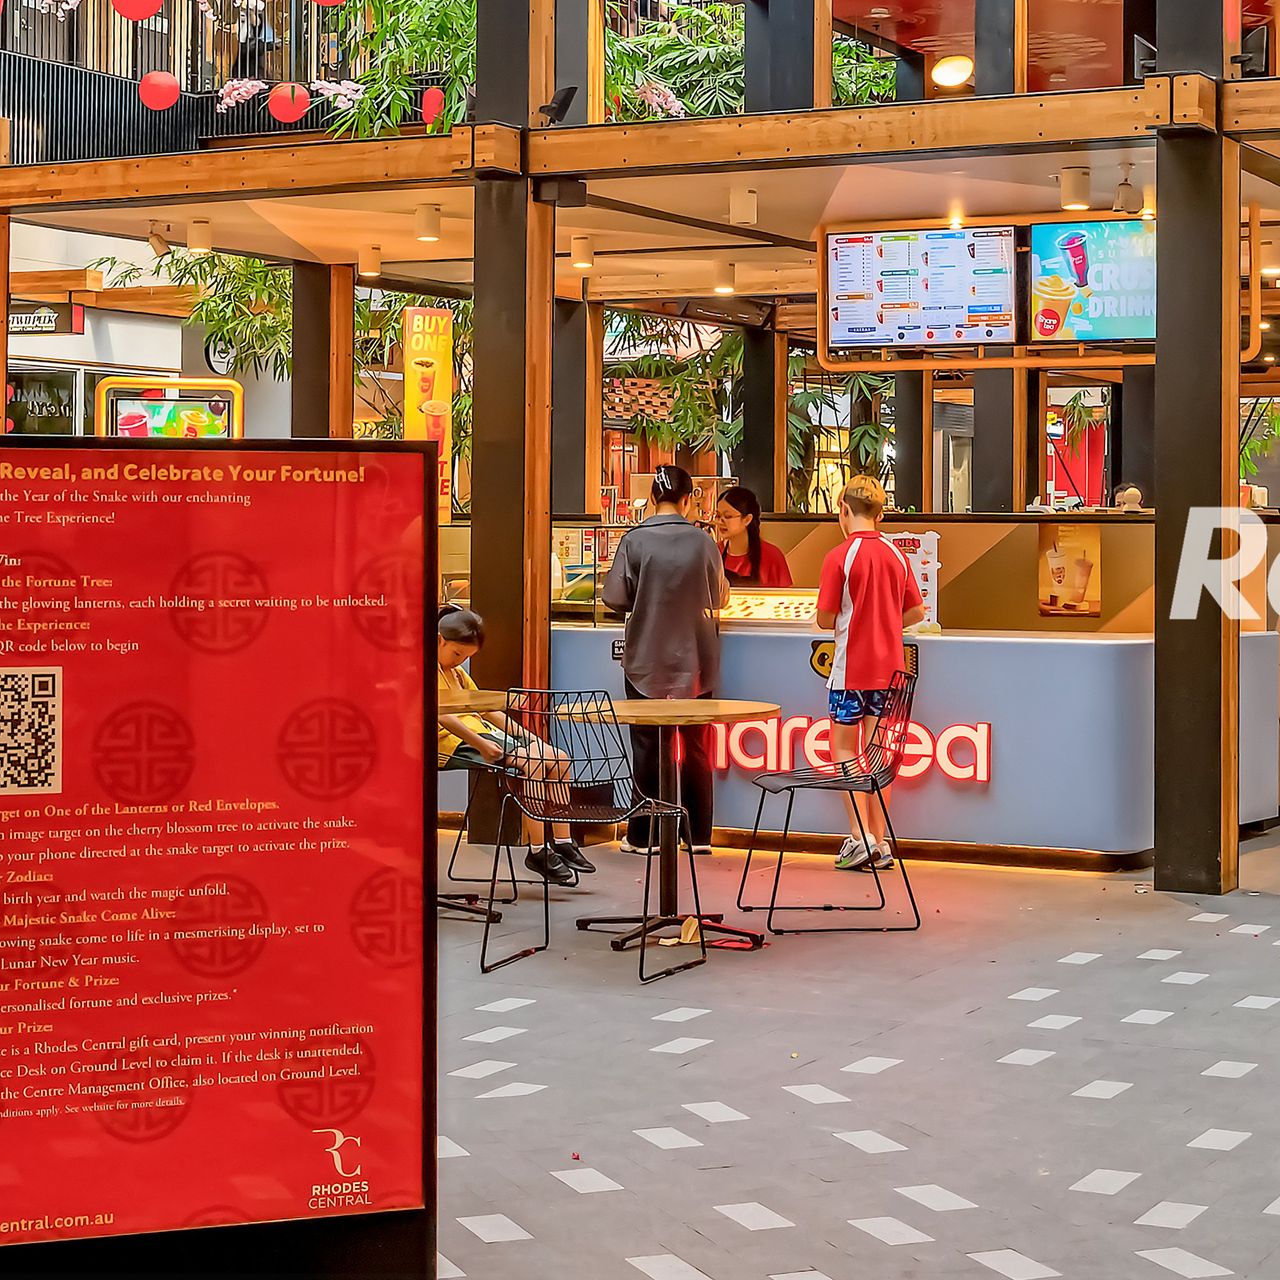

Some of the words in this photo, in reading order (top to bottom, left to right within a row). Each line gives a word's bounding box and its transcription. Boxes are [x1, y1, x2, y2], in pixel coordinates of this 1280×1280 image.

[412, 314, 449, 334] BUY
[411, 333, 448, 352] ONE
[0, 462, 76, 482] Reveal,
[81, 463, 119, 480] and
[123, 463, 223, 481] Celebrate
[228, 465, 276, 481] Your
[280, 465, 365, 482] Fortune!
[13, 510, 42, 523] Tree
[46, 511, 115, 526] Experience!
[1, 575, 21, 587] the
[26, 575, 76, 587] Fortune
[80, 575, 112, 587] Tree:
[17, 618, 90, 633] Experience:
[18, 639, 47, 652] code
[51, 638, 87, 651] below
[90, 642, 103, 651] to
[106, 638, 139, 654] begin
[24, 809, 40, 817] on
[44, 805, 71, 817] One
[74, 803, 89, 816] of
[91, 803, 110, 815] the
[114, 802, 168, 814] Lanterns
[171, 804, 184, 812] or
[189, 799, 212, 812] Red
[216, 798, 279, 813] Envelopes.
[6, 870, 53, 883] Zodiac:
[3, 913, 56, 928] Majestic
[59, 910, 97, 924] Snake
[100, 910, 137, 921] Come
[141, 907, 176, 919] Alive:
[1, 958, 37, 970] Lunar
[40, 955, 69, 968] New
[71, 954, 98, 966] Year
[102, 952, 139, 964] music.
[14, 978, 64, 990] Fortune
[68, 976, 79, 987] &
[85, 974, 119, 987] Prize:
[17, 1021, 53, 1033] Prize:
[0, 1086, 19, 1100] the
[23, 1085, 64, 1098] Centre
[68, 1082, 145, 1097] Management
[148, 1075, 188, 1089] Office,
[192, 1073, 214, 1086] also
[218, 1070, 258, 1085] located
[261, 1073, 276, 1081] on
[280, 1065, 325, 1080] Ground
[329, 1063, 360, 1077] Level.
[64, 1104, 79, 1113] See
[81, 1102, 114, 1112] website
[116, 1100, 128, 1110] for
[131, 1101, 154, 1109] more
[312, 1181, 369, 1196] RHODES
[308, 1194, 372, 1209] CENTRAL
